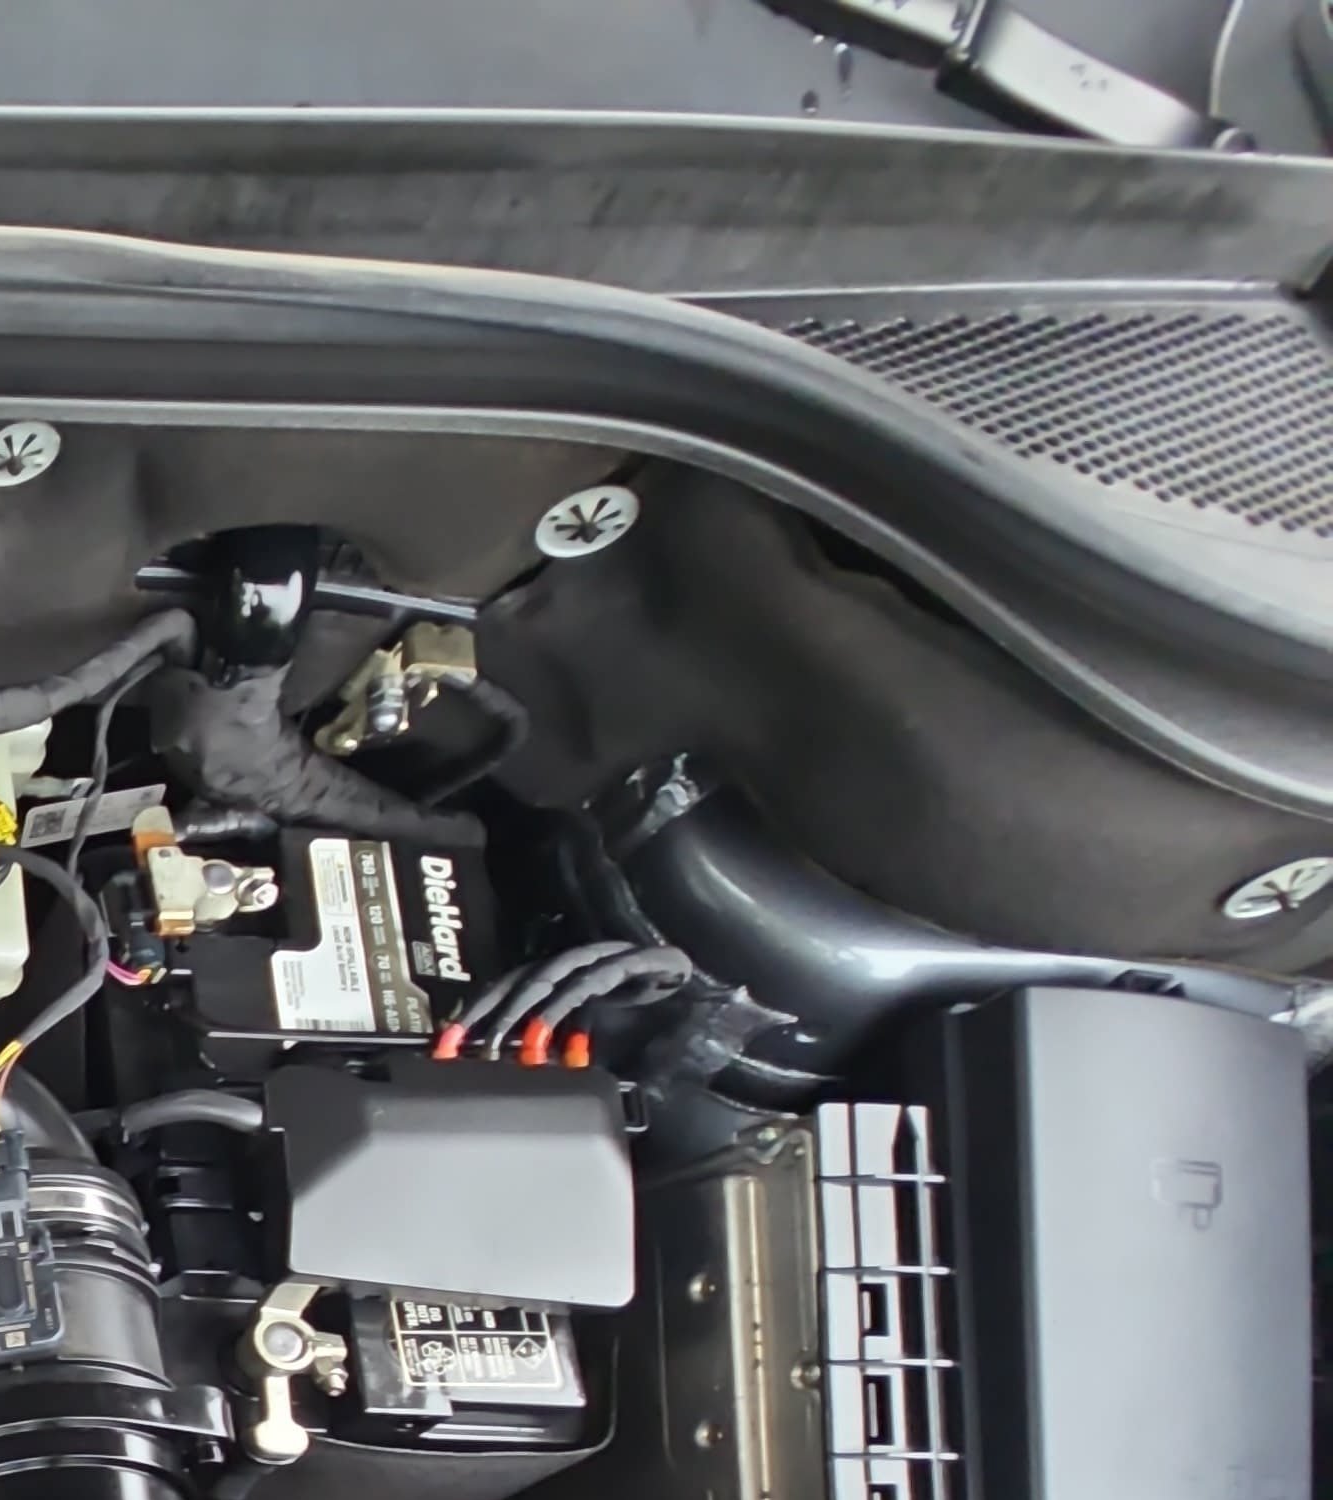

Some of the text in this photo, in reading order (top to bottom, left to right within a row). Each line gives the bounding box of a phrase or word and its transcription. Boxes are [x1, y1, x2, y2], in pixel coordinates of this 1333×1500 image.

[369, 905, 383, 924] 120
[377, 955, 391, 970] 70
[420, 855, 471, 981] DieHard
[417, 1304, 431, 1324] NOT
